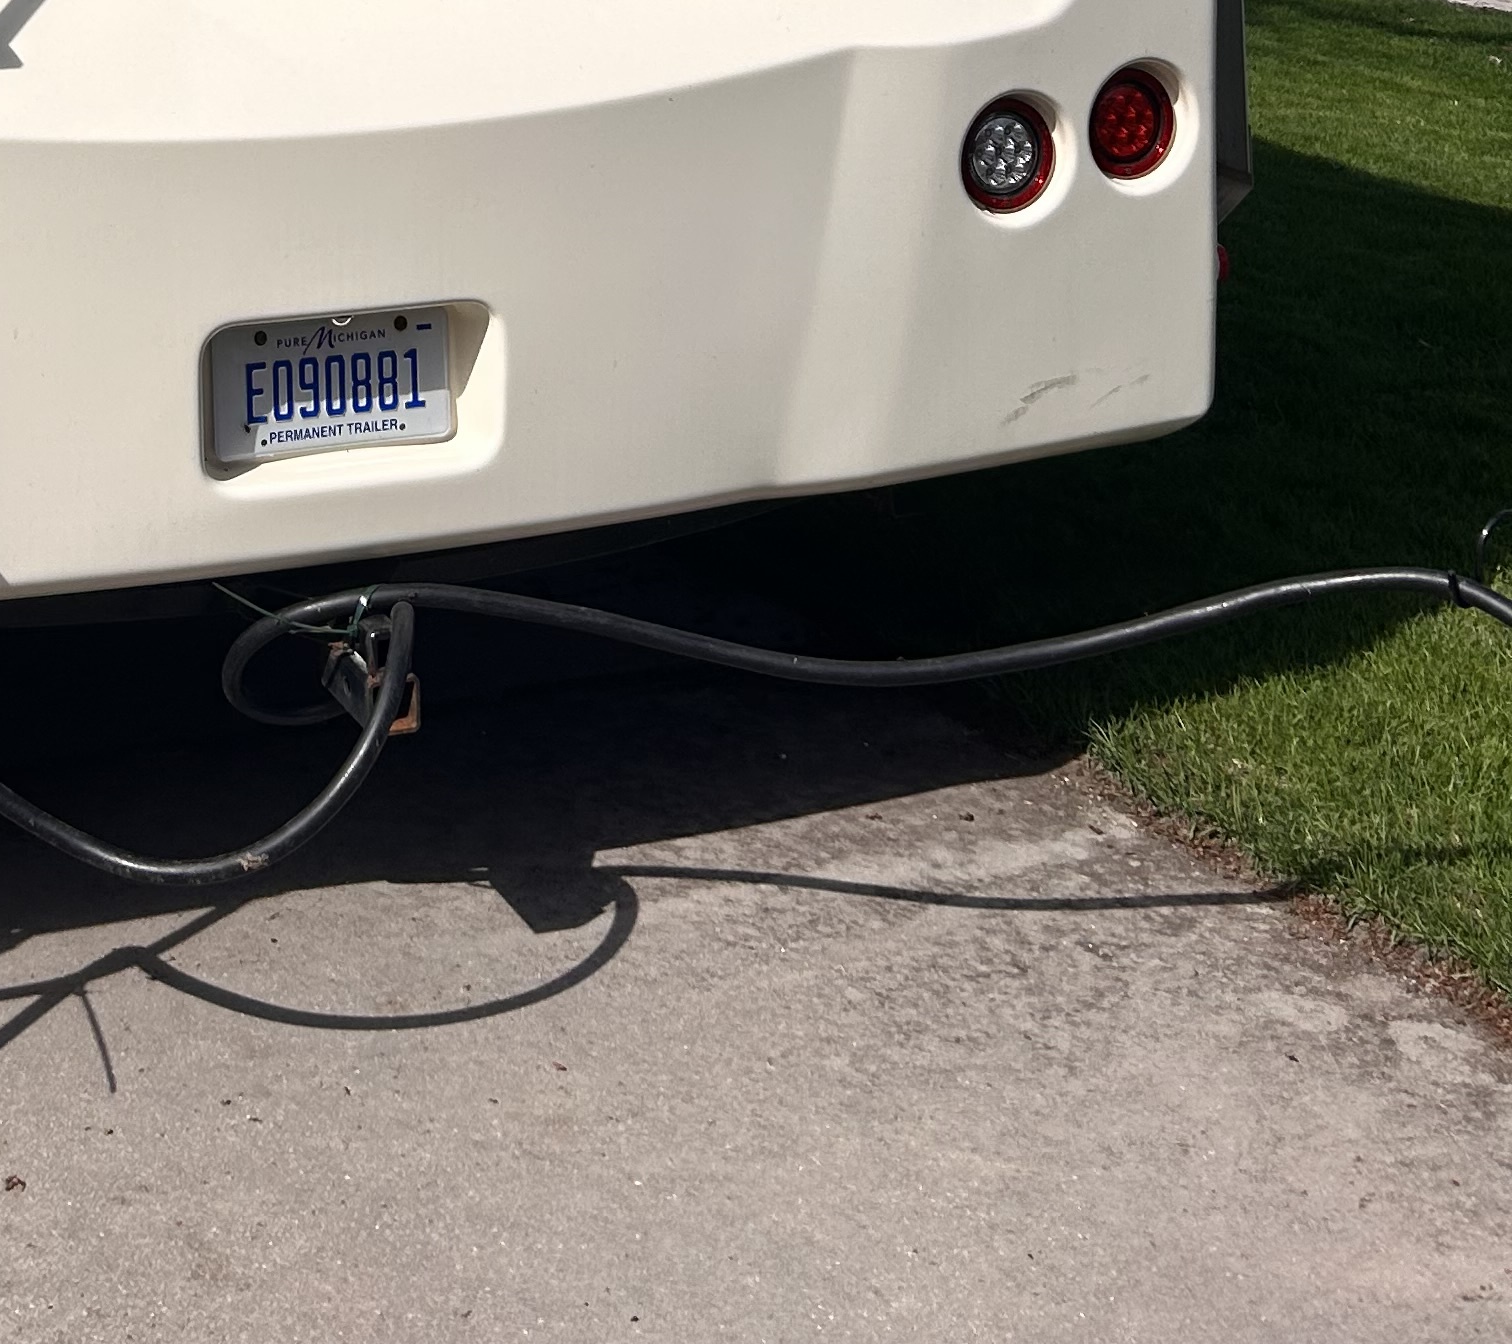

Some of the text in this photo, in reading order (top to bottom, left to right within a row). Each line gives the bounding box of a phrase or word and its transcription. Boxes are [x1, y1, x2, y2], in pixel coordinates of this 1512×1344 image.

[276, 336, 308, 349] PURE
[245, 348, 426, 424] E090881
[269, 419, 398, 444] PERMANENT TRAILER
